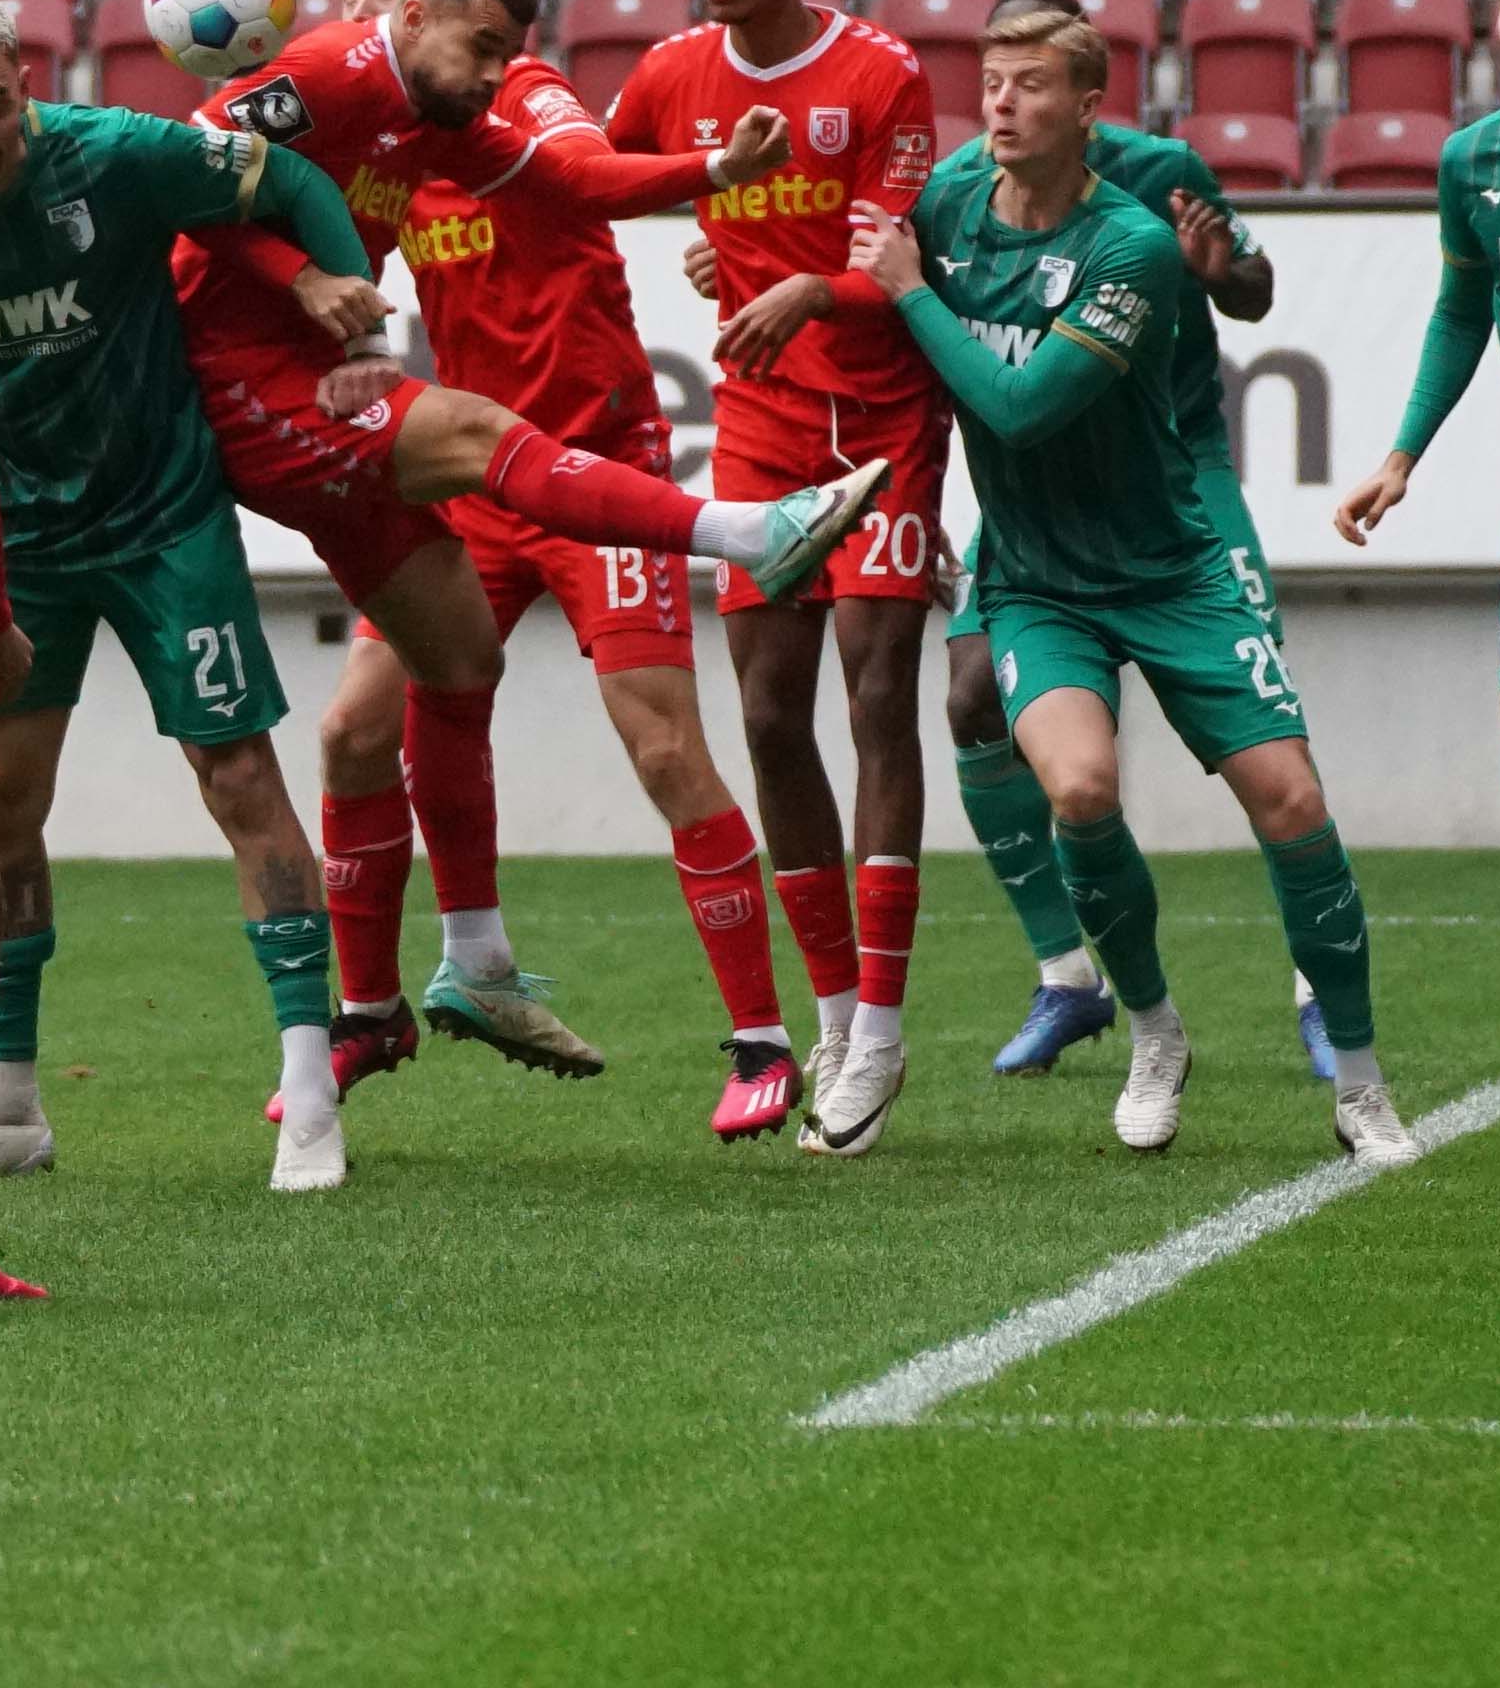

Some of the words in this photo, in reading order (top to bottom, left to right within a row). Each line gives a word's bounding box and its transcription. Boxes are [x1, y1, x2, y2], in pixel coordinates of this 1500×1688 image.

[346, 165, 411, 224] Nett
[709, 174, 844, 220] Netto
[400, 216, 494, 266] Netto
[860, 511, 926, 577] 20
[596, 546, 648, 609] 13
[1229, 547, 1267, 604] 5
[187, 621, 247, 698] 21
